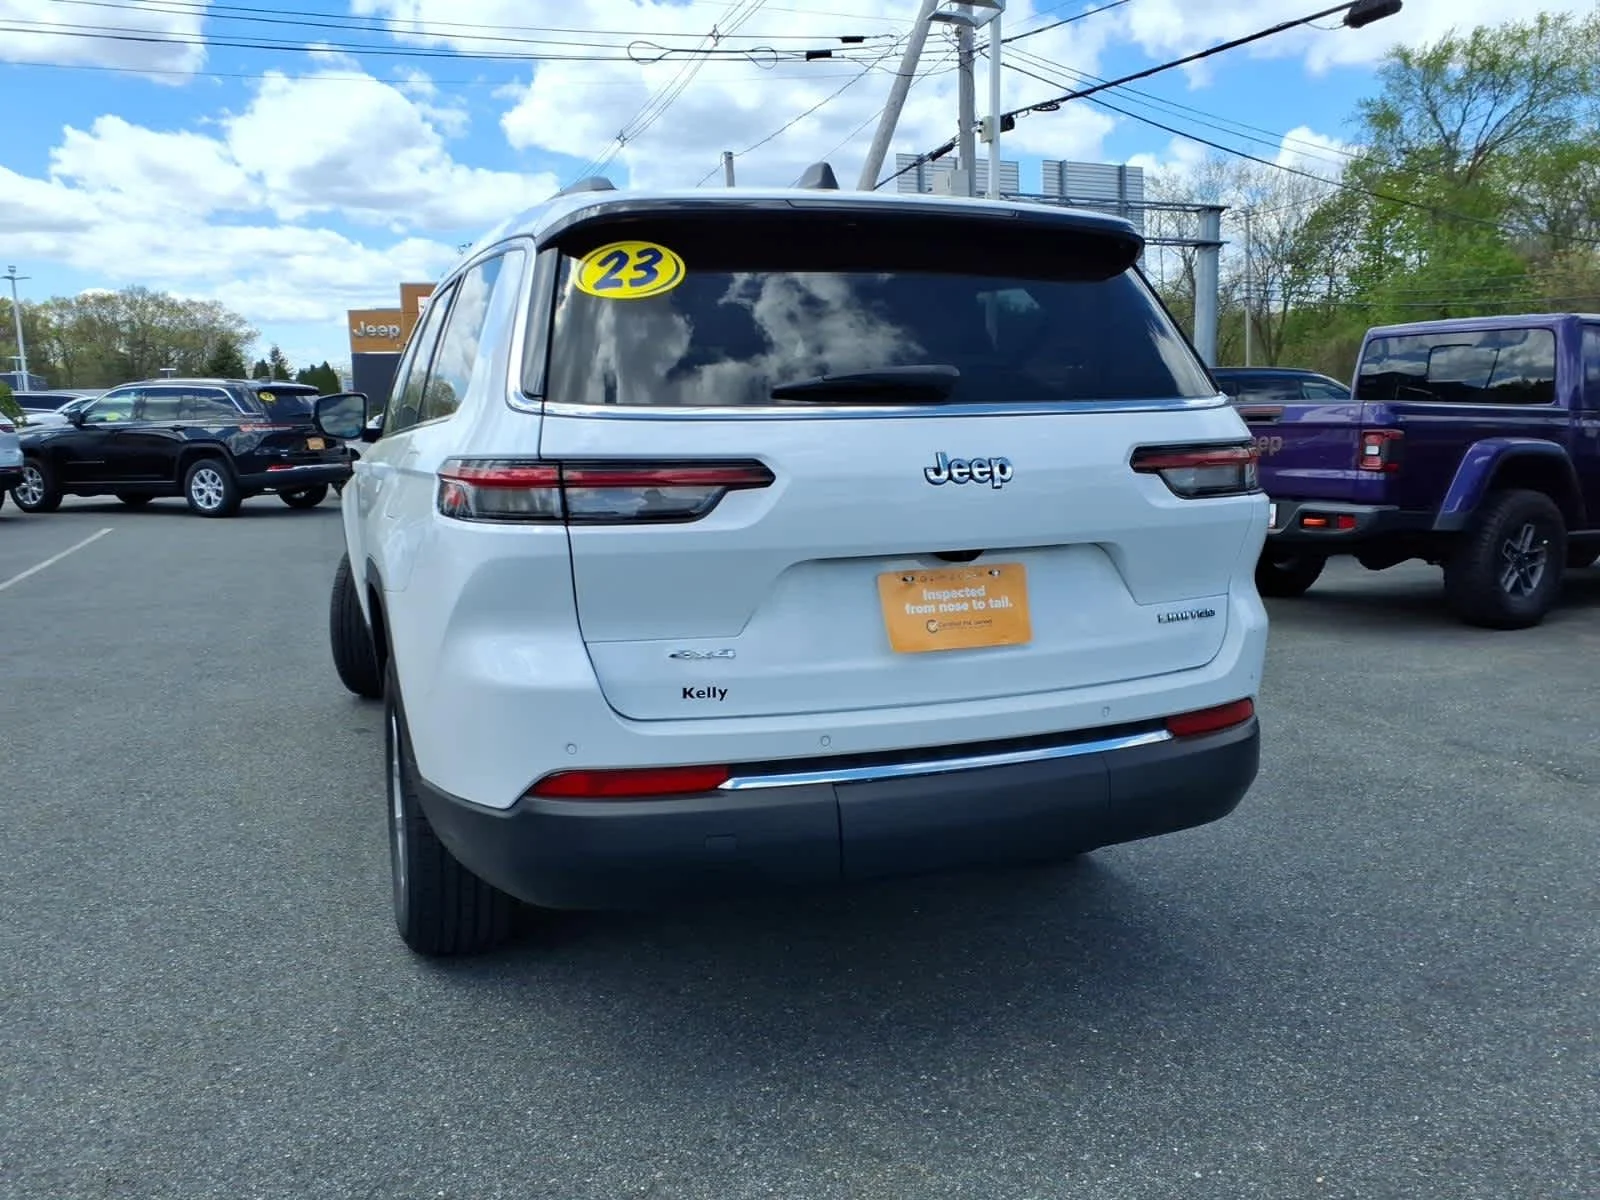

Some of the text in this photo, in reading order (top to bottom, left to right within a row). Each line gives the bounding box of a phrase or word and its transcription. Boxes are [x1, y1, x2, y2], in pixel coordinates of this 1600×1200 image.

[592, 247, 664, 290] 23
[353, 321, 400, 340] Jeep
[924, 452, 1013, 489] Jeep
[923, 585, 986, 601] Inspected
[904, 602, 936, 615] from
[938, 602, 970, 614] nose
[972, 599, 986, 611] to
[682, 686, 728, 701] Kelly
